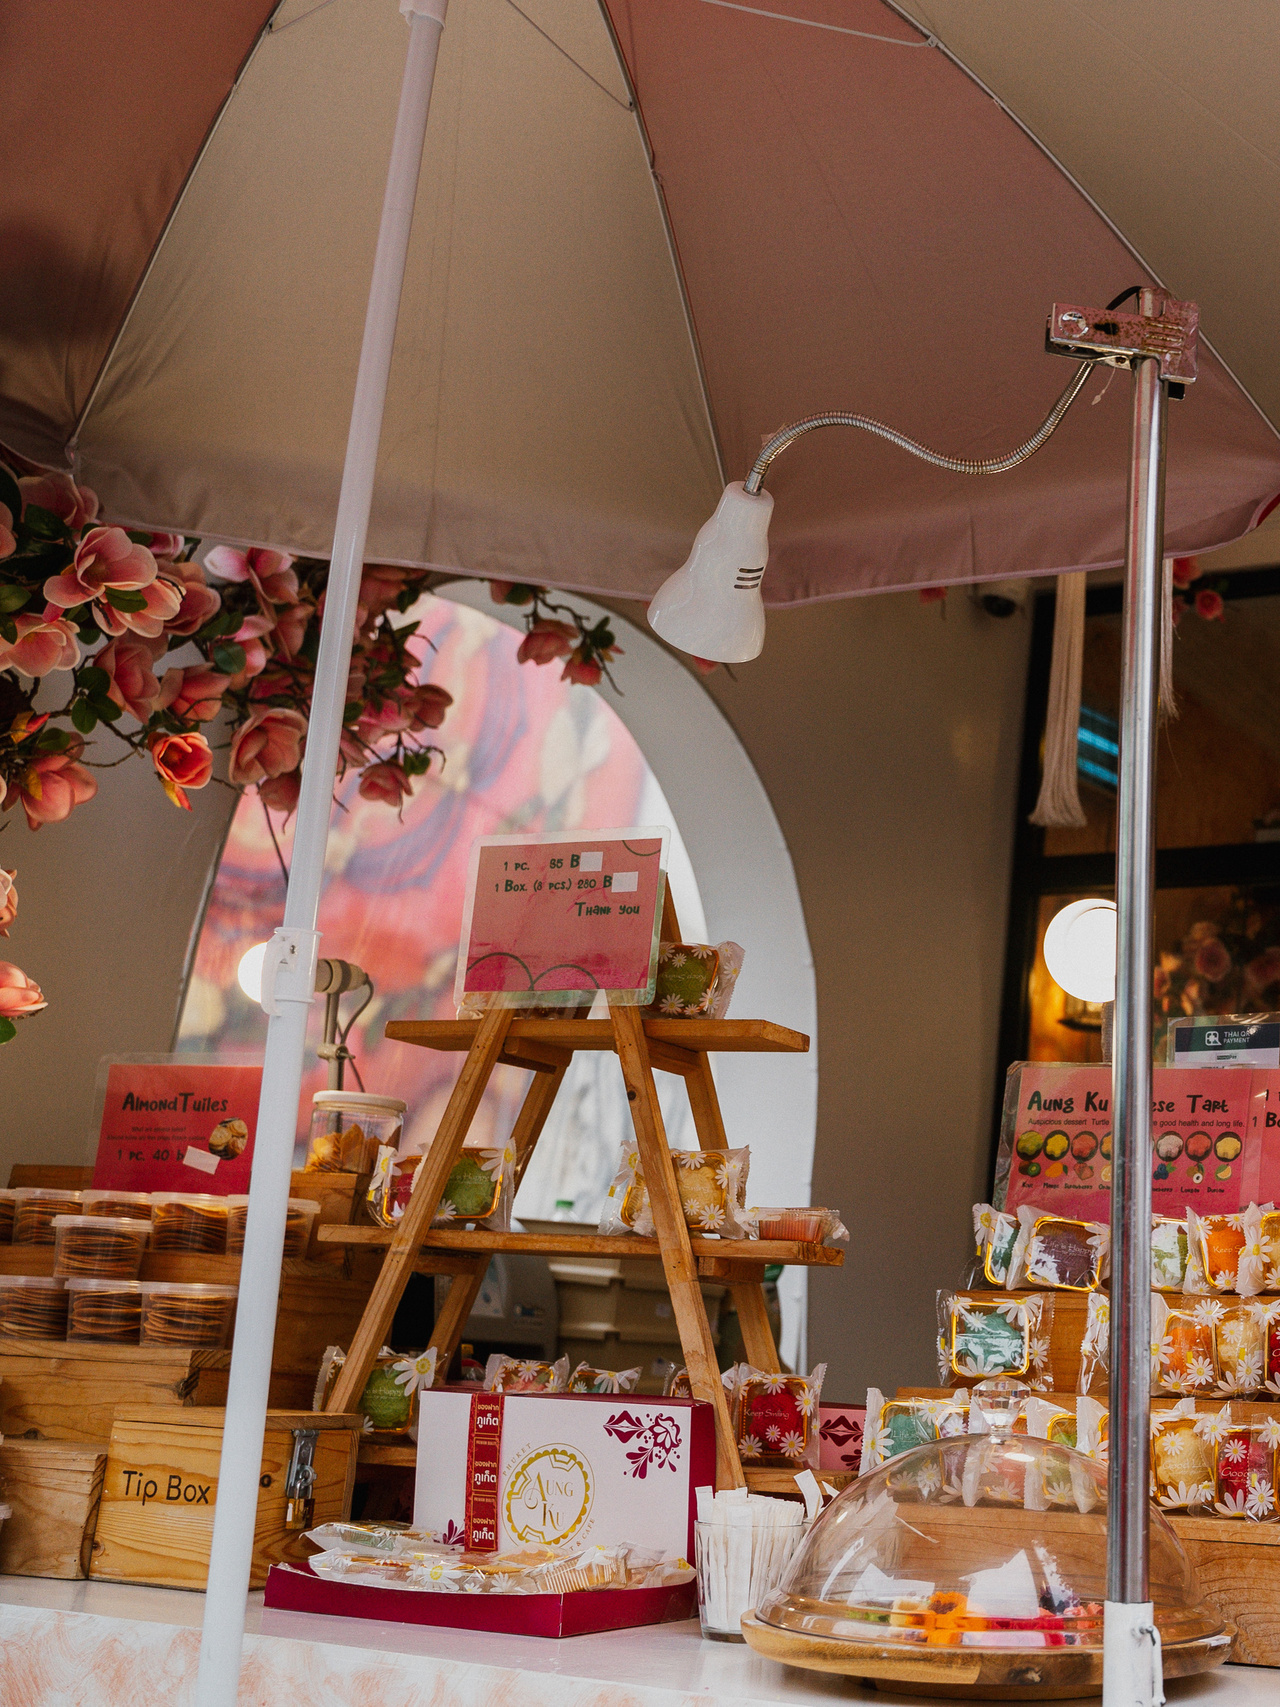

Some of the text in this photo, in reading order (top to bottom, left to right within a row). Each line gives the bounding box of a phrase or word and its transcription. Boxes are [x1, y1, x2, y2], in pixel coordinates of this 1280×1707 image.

[504, 861, 508, 871] 1
[495, 883, 499, 892] 1
[504, 879, 527, 892] Box.
[577, 879, 597, 889] 280
[575, 902, 640, 916] Thank you
[122, 1092, 229, 1113] Almond Tuiles
[1027, 1091, 1074, 1113] Aung
[1084, 1091, 1109, 1112] Ku
[1187, 1094, 1229, 1113] Tart
[1028, 1118, 1062, 1126] Auspicious
[1063, 1118, 1087, 1126] dessert
[1092, 1118, 1110, 1126] Turtle
[1160, 1119, 1177, 1128] good
[1178, 1119, 1199, 1127] health
[1201, 1119, 1214, 1127] and
[1216, 1120, 1231, 1128] long
[1252, 1116, 1257, 1128] 1
[117, 1150, 122, 1161] 1
[152, 1150, 170, 1161] 40
[476, 1413, 499, 1429] ภูเก็ต
[744, 1408, 790, 1420] Keep Smiling
[503, 1443, 532, 1476] PHUKET
[474, 1470, 497, 1486] ภูเก็ต
[123, 1470, 211, 1506] Tip Box
[472, 1526, 495, 1543] ภูเก็ต
